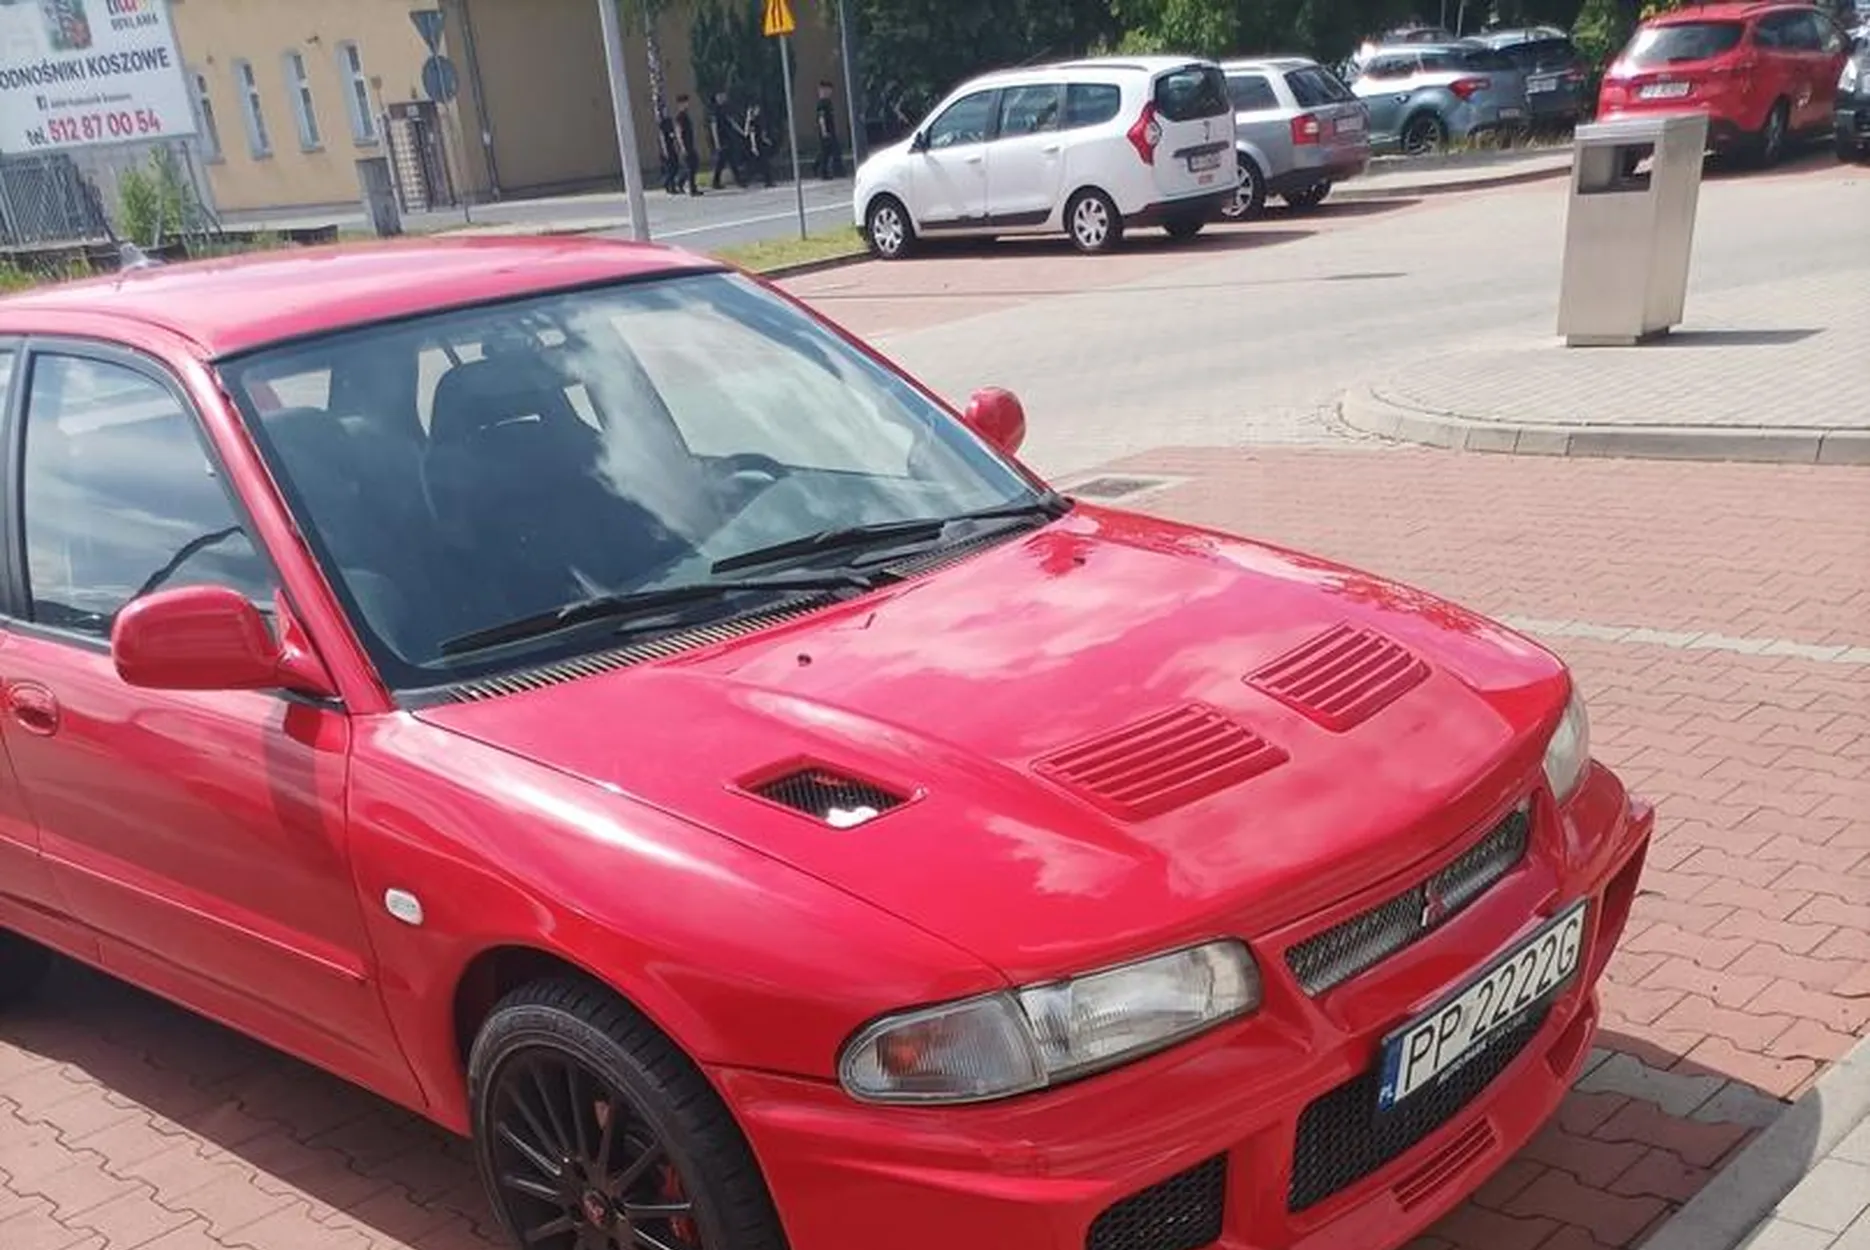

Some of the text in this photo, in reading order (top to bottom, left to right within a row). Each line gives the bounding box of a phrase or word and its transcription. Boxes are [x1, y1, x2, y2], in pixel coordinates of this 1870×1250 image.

[86, 48, 170, 77] KOSZOWE
[48, 117, 81, 143] 512
[82, 114, 102, 139] 87
[107, 111, 133, 136] 00
[135, 108, 161, 133] 54
[1404, 1004, 1462, 1092] PP
[1469, 918, 1578, 1042] 2222G
